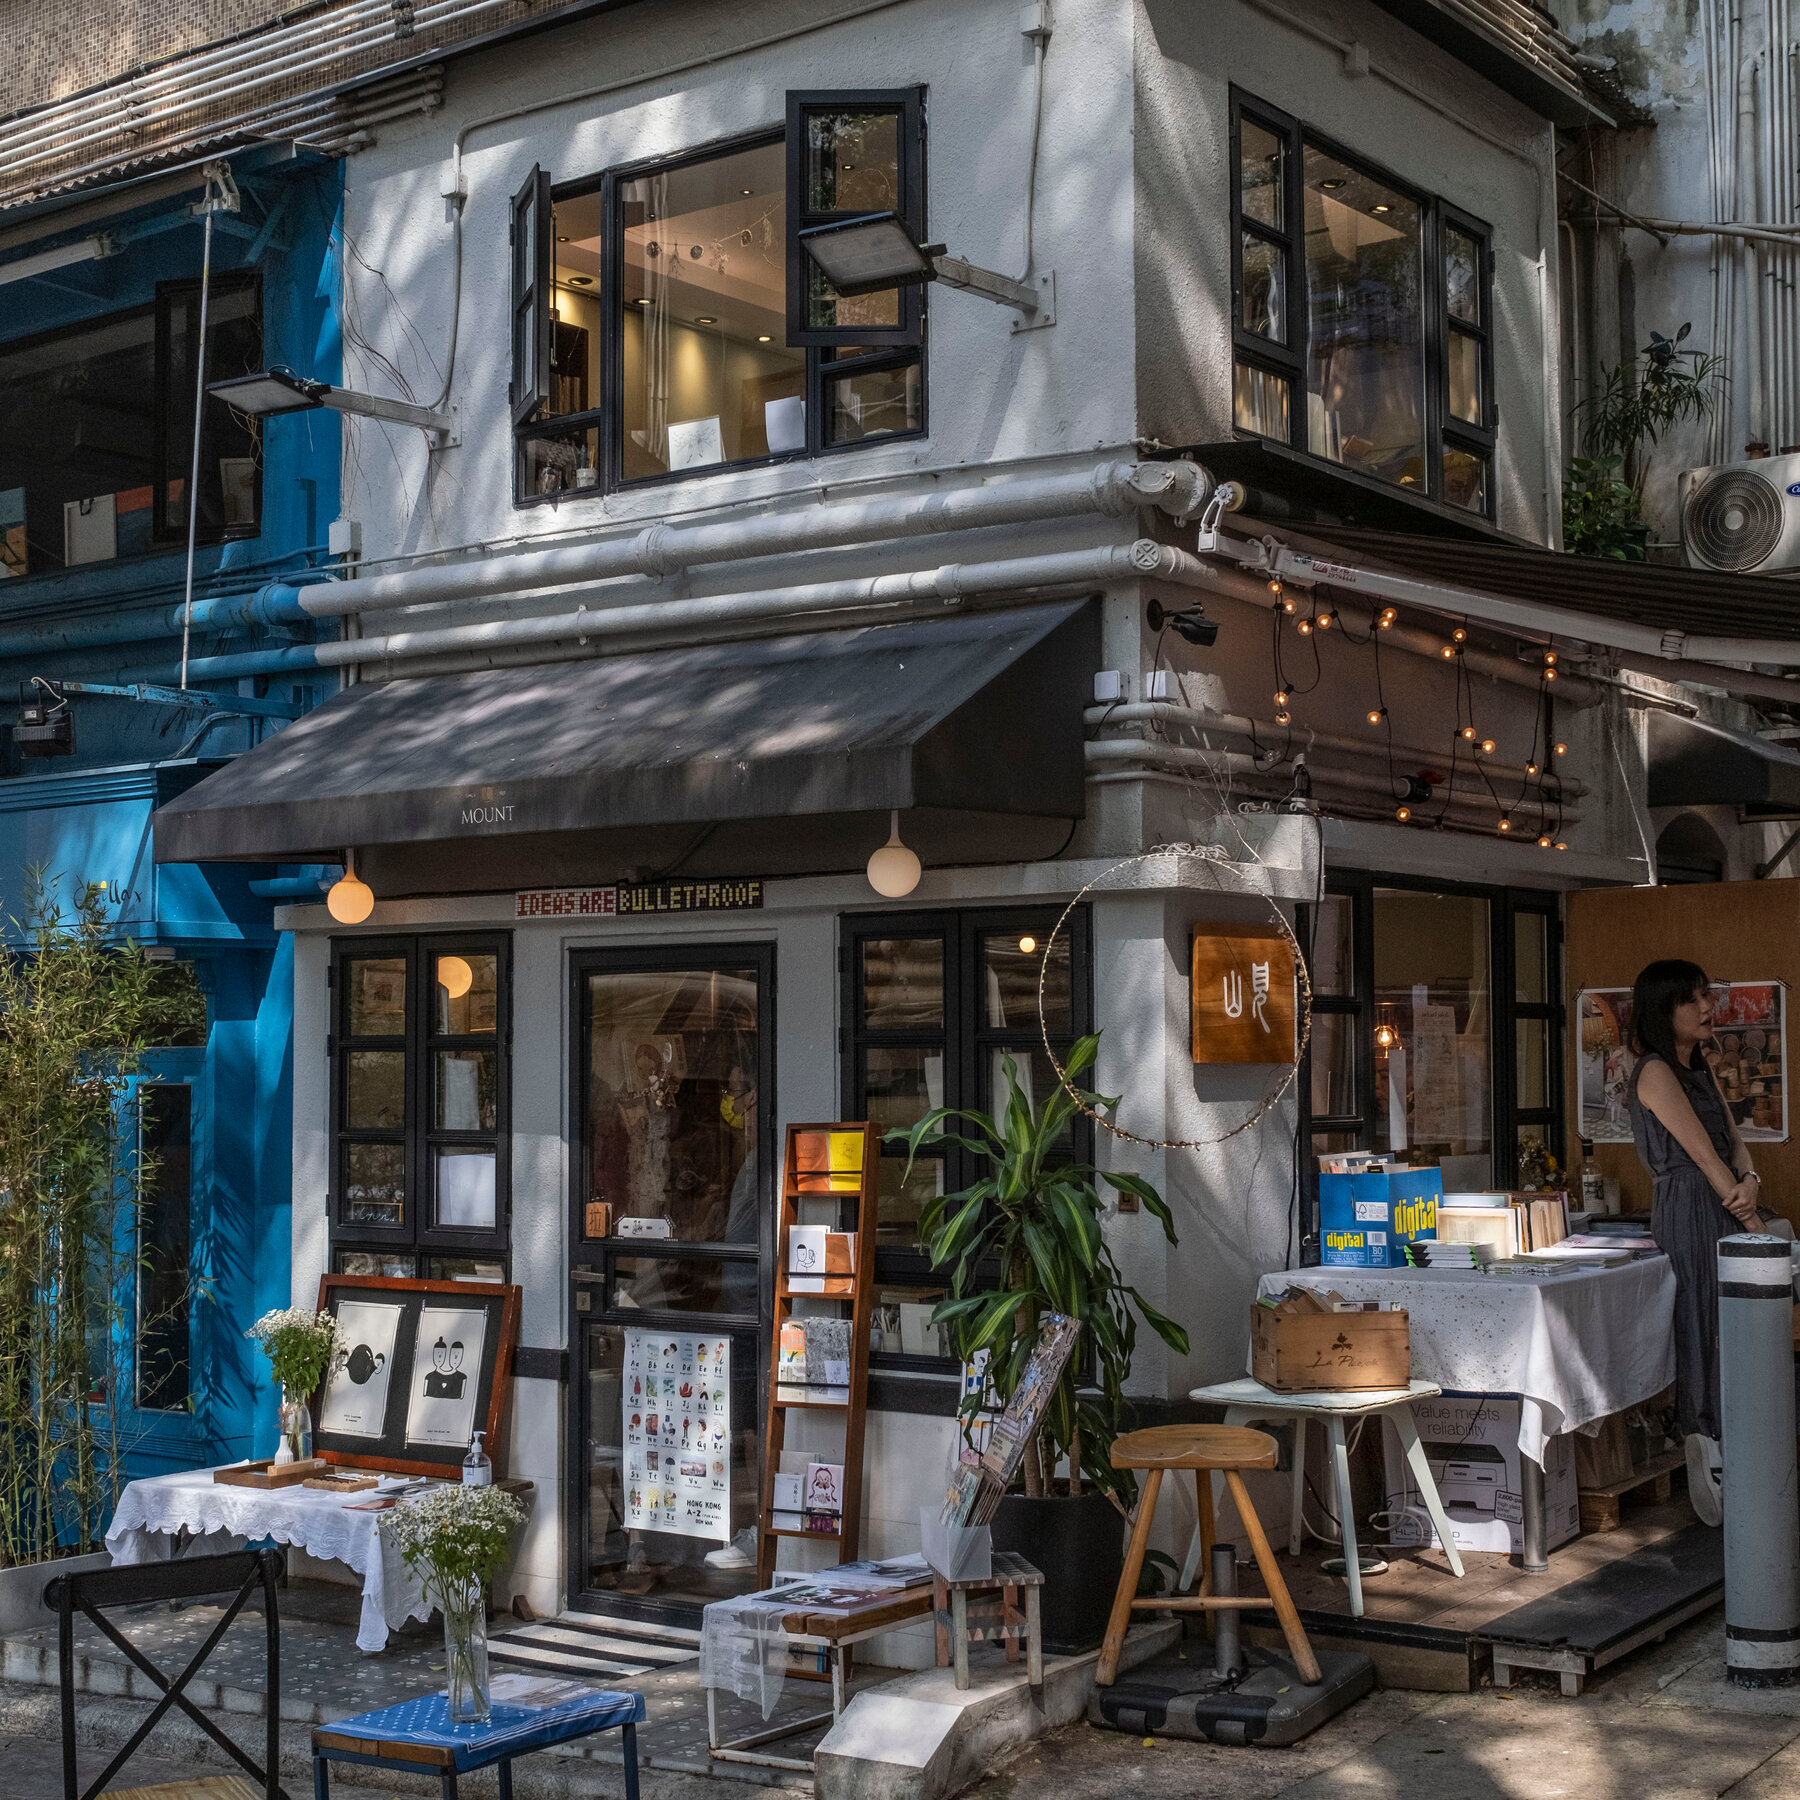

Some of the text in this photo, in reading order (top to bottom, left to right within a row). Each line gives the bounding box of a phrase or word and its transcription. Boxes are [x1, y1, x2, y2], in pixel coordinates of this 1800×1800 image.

[461, 805, 515, 824] MOUNT
[517, 882, 760, 917] IDEAS ARE BULLETPROOF
[1394, 1194, 1439, 1240] digital
[1326, 1232, 1365, 1250] digital
[1372, 1246, 1383, 1255] 80
[1410, 1403, 1500, 1421] Value meets
[1427, 1421, 1487, 1439] reliability
[686, 1499, 722, 1511] HONG KONG
[686, 1508, 701, 1517] A-Z
[1395, 1529, 1461, 1538] HL-L23D
